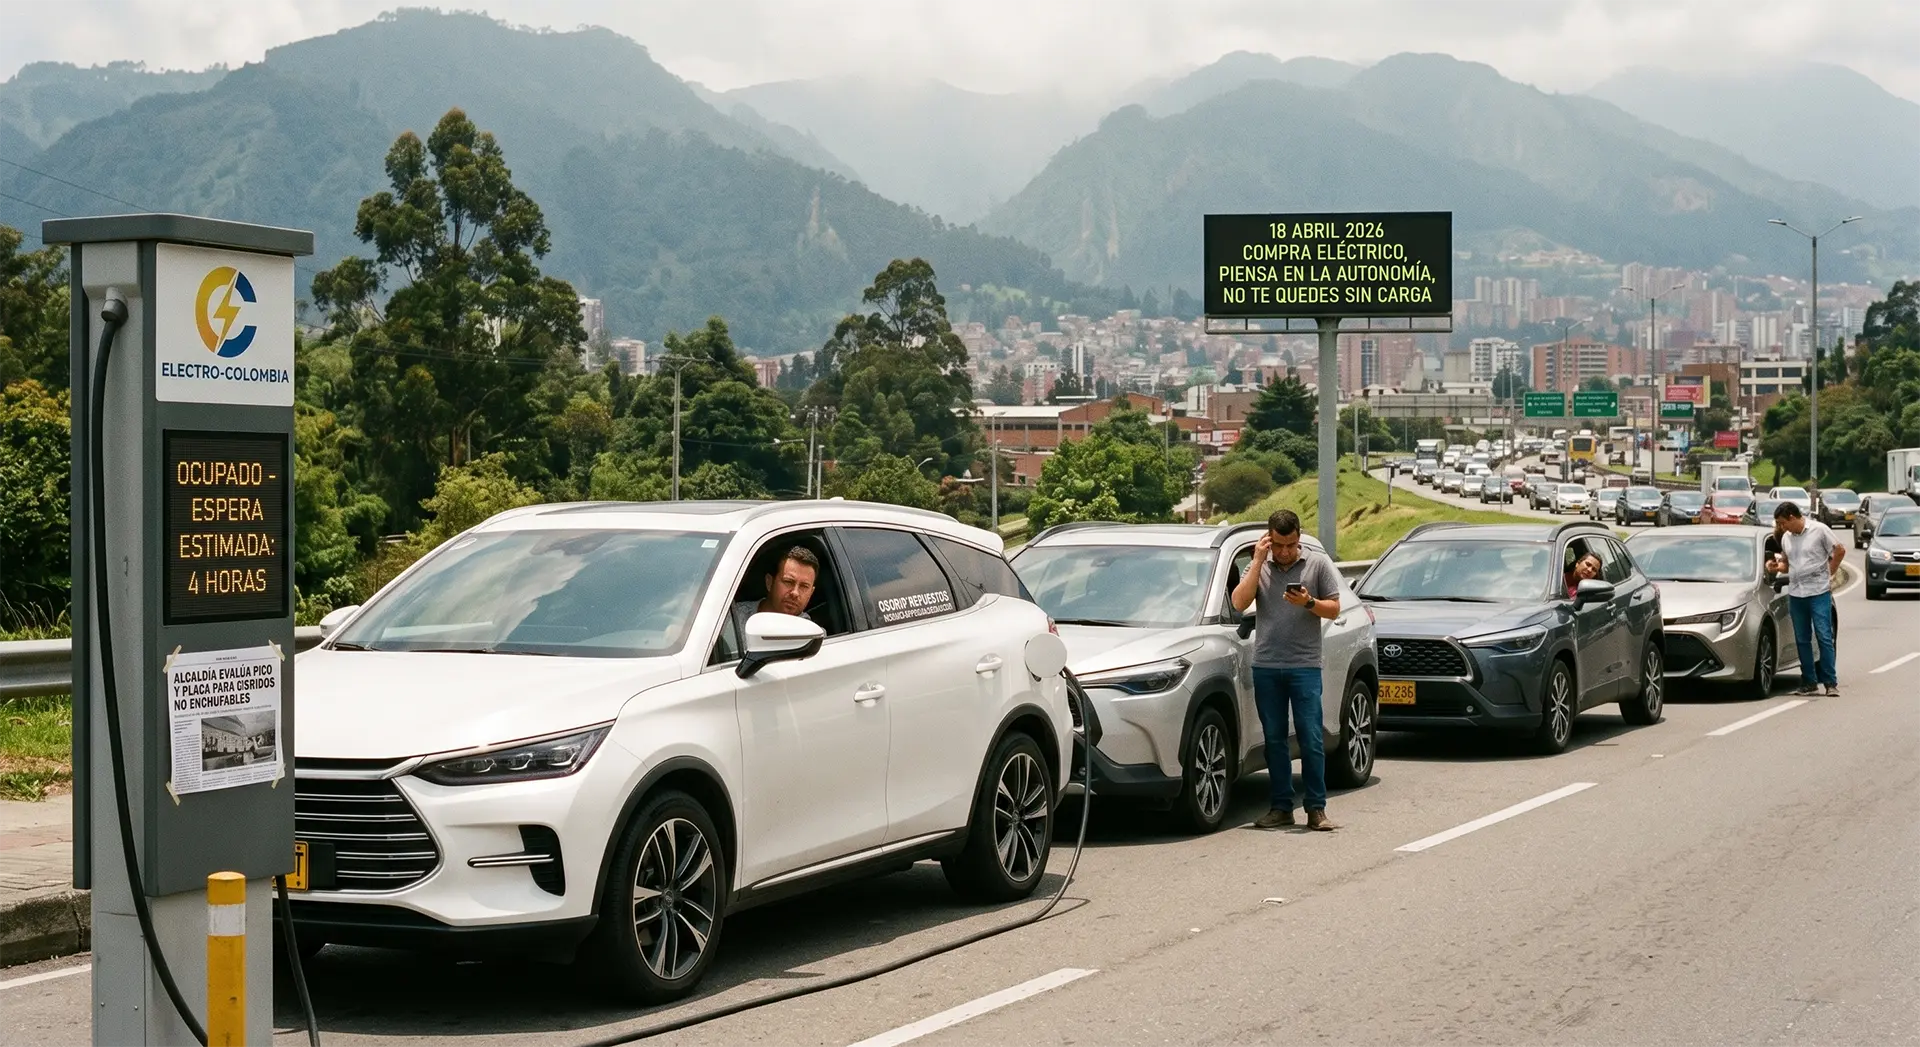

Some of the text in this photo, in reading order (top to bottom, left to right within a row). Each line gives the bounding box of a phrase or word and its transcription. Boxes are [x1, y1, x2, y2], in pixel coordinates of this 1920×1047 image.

[1269, 222, 1385, 239] 18 ABRIL 2026
[1243, 240, 1408, 263] COMPRA ELÉCTRICO,
[1219, 260, 1436, 284] PIENSA EN LA AUTONOMÍA,
[1223, 286, 1432, 304] NO TE QUEDES SIN CARGA
[162, 362, 290, 384] ELECTRO-COLOMBIA
[177, 461, 262, 486] OCUPADO
[192, 497, 264, 522] ESPERA
[180, 533, 275, 558] ESTIMADA:
[188, 568, 266, 595] 4 HORAS
[174, 664, 273, 684] ALCALDÍA EVALÚA PICO
[174, 686, 181, 697] Y
[182, 683, 211, 697] PLACA
[212, 680, 235, 694] PARA
[174, 699, 187, 711] NO
[190, 693, 251, 709] ENCHUFABLES
